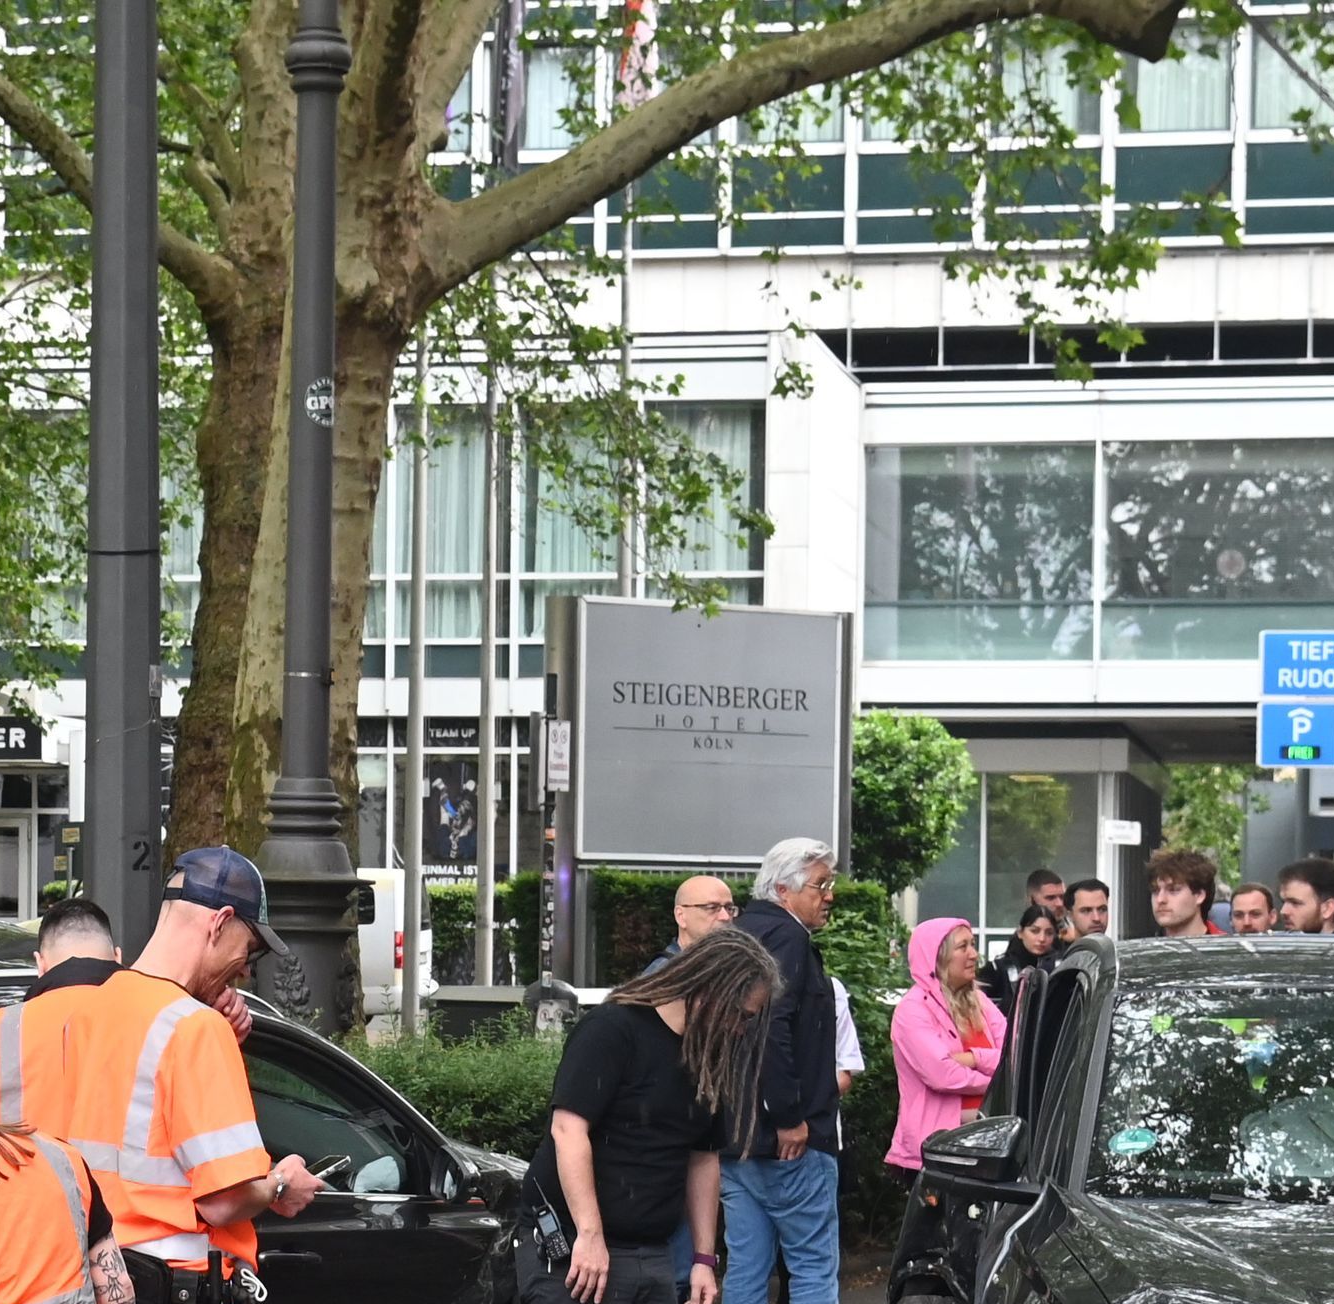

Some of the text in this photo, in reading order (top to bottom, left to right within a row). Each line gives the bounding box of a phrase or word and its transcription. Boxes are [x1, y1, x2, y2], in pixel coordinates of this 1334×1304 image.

[612, 681, 809, 711] STEIGENBERGER
[655, 714, 770, 732] HOTEL
[428, 728, 476, 738] TEAM UP
[693, 735, 734, 750] KÖLN
